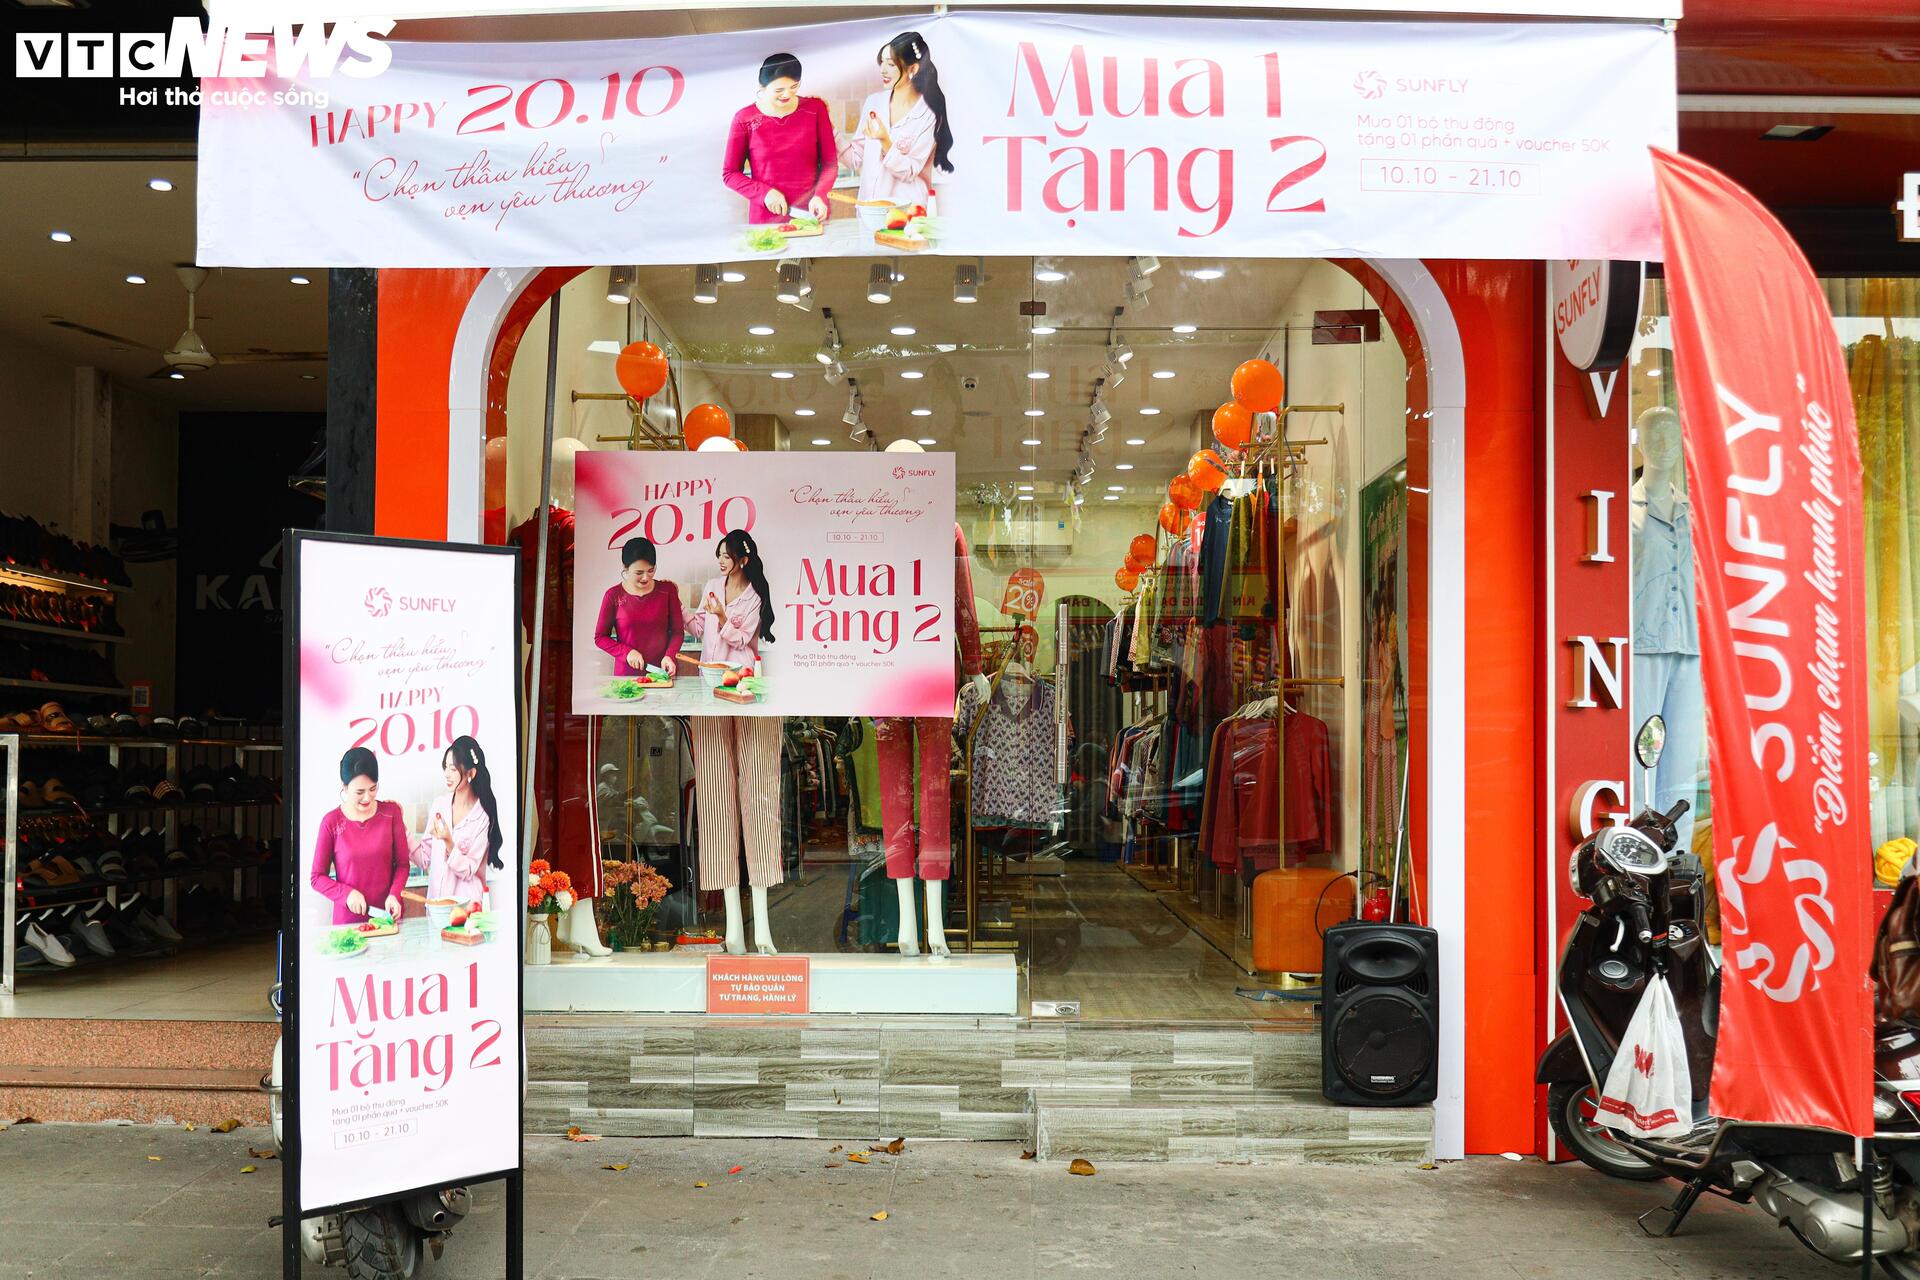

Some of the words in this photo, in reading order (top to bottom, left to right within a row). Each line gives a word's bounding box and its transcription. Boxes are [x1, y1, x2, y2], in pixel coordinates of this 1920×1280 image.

[1006, 41, 1225, 119] Mua
[1254, 51, 1283, 119] 1
[1396, 78, 1470, 94] SUNFLY
[310, 101, 448, 149] HAPPY
[456, 65, 686, 136] 20.10
[1357, 114, 1392, 129] Mua
[1396, 115, 1413, 129] 01
[1443, 116, 1469, 131] thu
[1473, 117, 1515, 135] đông
[1399, 132, 1417, 147] 01
[1515, 137, 1577, 152] voucher
[1581, 138, 1611, 152] 50K
[445, 149, 519, 190] thấu
[522, 141, 581, 179] hiểu
[982, 120, 1234, 238] Tặng
[1265, 135, 1327, 213] 2
[1380, 165, 1437, 185] 10.10
[1468, 168, 1521, 188] 21.10
[495, 191, 546, 232] yêu
[1557, 265, 1601, 335] SUNFLY
[908, 469, 937, 477] SUNFLY
[644, 477, 717, 502] HAPPY
[607, 495, 757, 551] 20.10
[852, 507, 877, 524] yêu
[1801, 497, 1844, 603] hạnh
[795, 558, 896, 597] Mua
[908, 559, 922, 597] 1
[1716, 382, 1796, 783] SUNFLY
[399, 597, 457, 613] SUNFLY
[785, 597, 900, 654] Tặng
[912, 603, 942, 643] 2
[1806, 601, 1846, 710] chạm
[380, 686, 445, 710] HAPPY
[348, 704, 480, 757] 20.10
[712, 973, 741, 982] KHÁCH
[741, 973, 765, 982] HÀNG
[766, 974, 780, 982] VUI
[781, 974, 804, 983] LÒNG
[730, 983, 743, 993] TỰ
[330, 973, 449, 1028] Mua
[463, 961, 478, 1009] 1
[731, 993, 762, 1002] TRANG,
[762, 993, 786, 1002] HÀNH
[787, 993, 797, 1002] LÝ
[315, 1027, 454, 1096] Tặng
[469, 1019, 502, 1070] 2
[331, 1107, 349, 1117] Mua
[350, 1105, 359, 1114] 01
[372, 1101, 385, 1110] thu
[351, 1114, 361, 1123] 01
[405, 1102, 434, 1113] voucher
[435, 1098, 449, 1109] 50K
[343, 1130, 371, 1144] 10.10
[384, 1123, 410, 1137] 21.10
